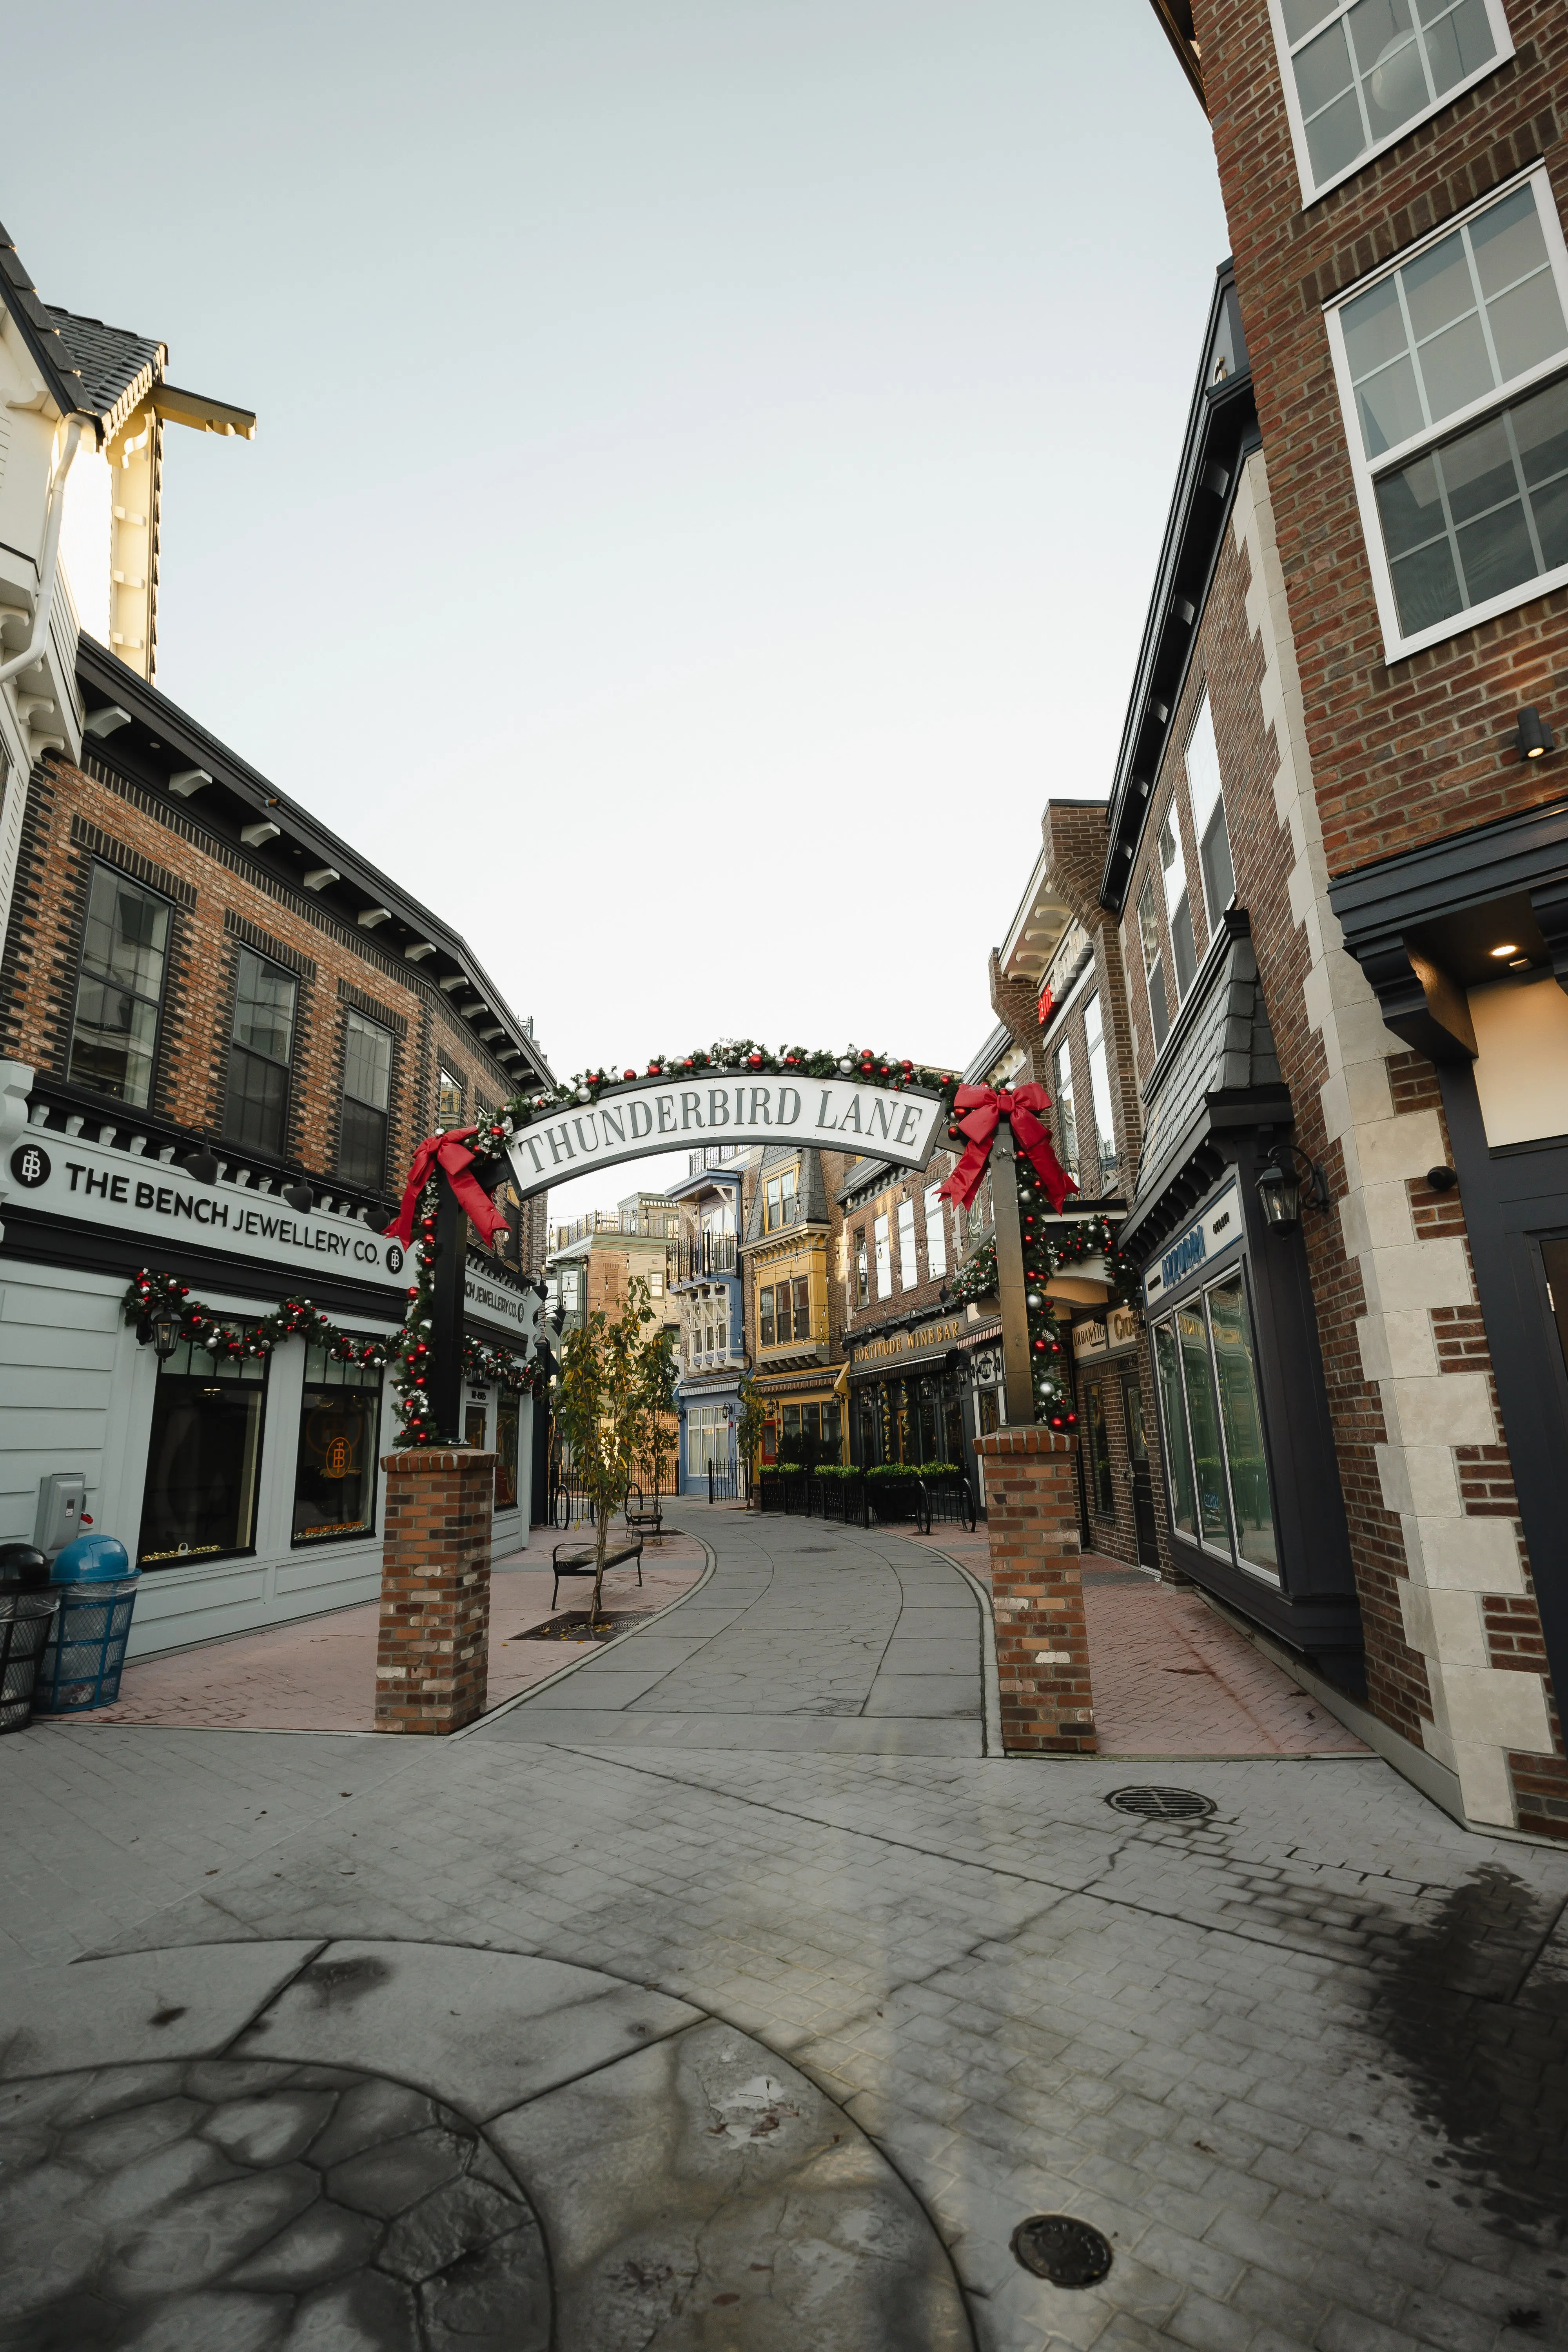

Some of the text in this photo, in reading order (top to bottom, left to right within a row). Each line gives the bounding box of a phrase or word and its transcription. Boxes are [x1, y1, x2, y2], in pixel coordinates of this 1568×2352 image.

[518, 1086, 924, 1173] THUNDERBIRD LANE
[66, 1162, 380, 1265] THE BENCH JEWELLERY CO.
[1161, 1225, 1206, 1289] AZZURRI
[475, 1286, 509, 1314] JEWELLERY
[509, 1301, 517, 1318] CO.
[854, 1321, 959, 1363] FORTITUDE WINE BAR
